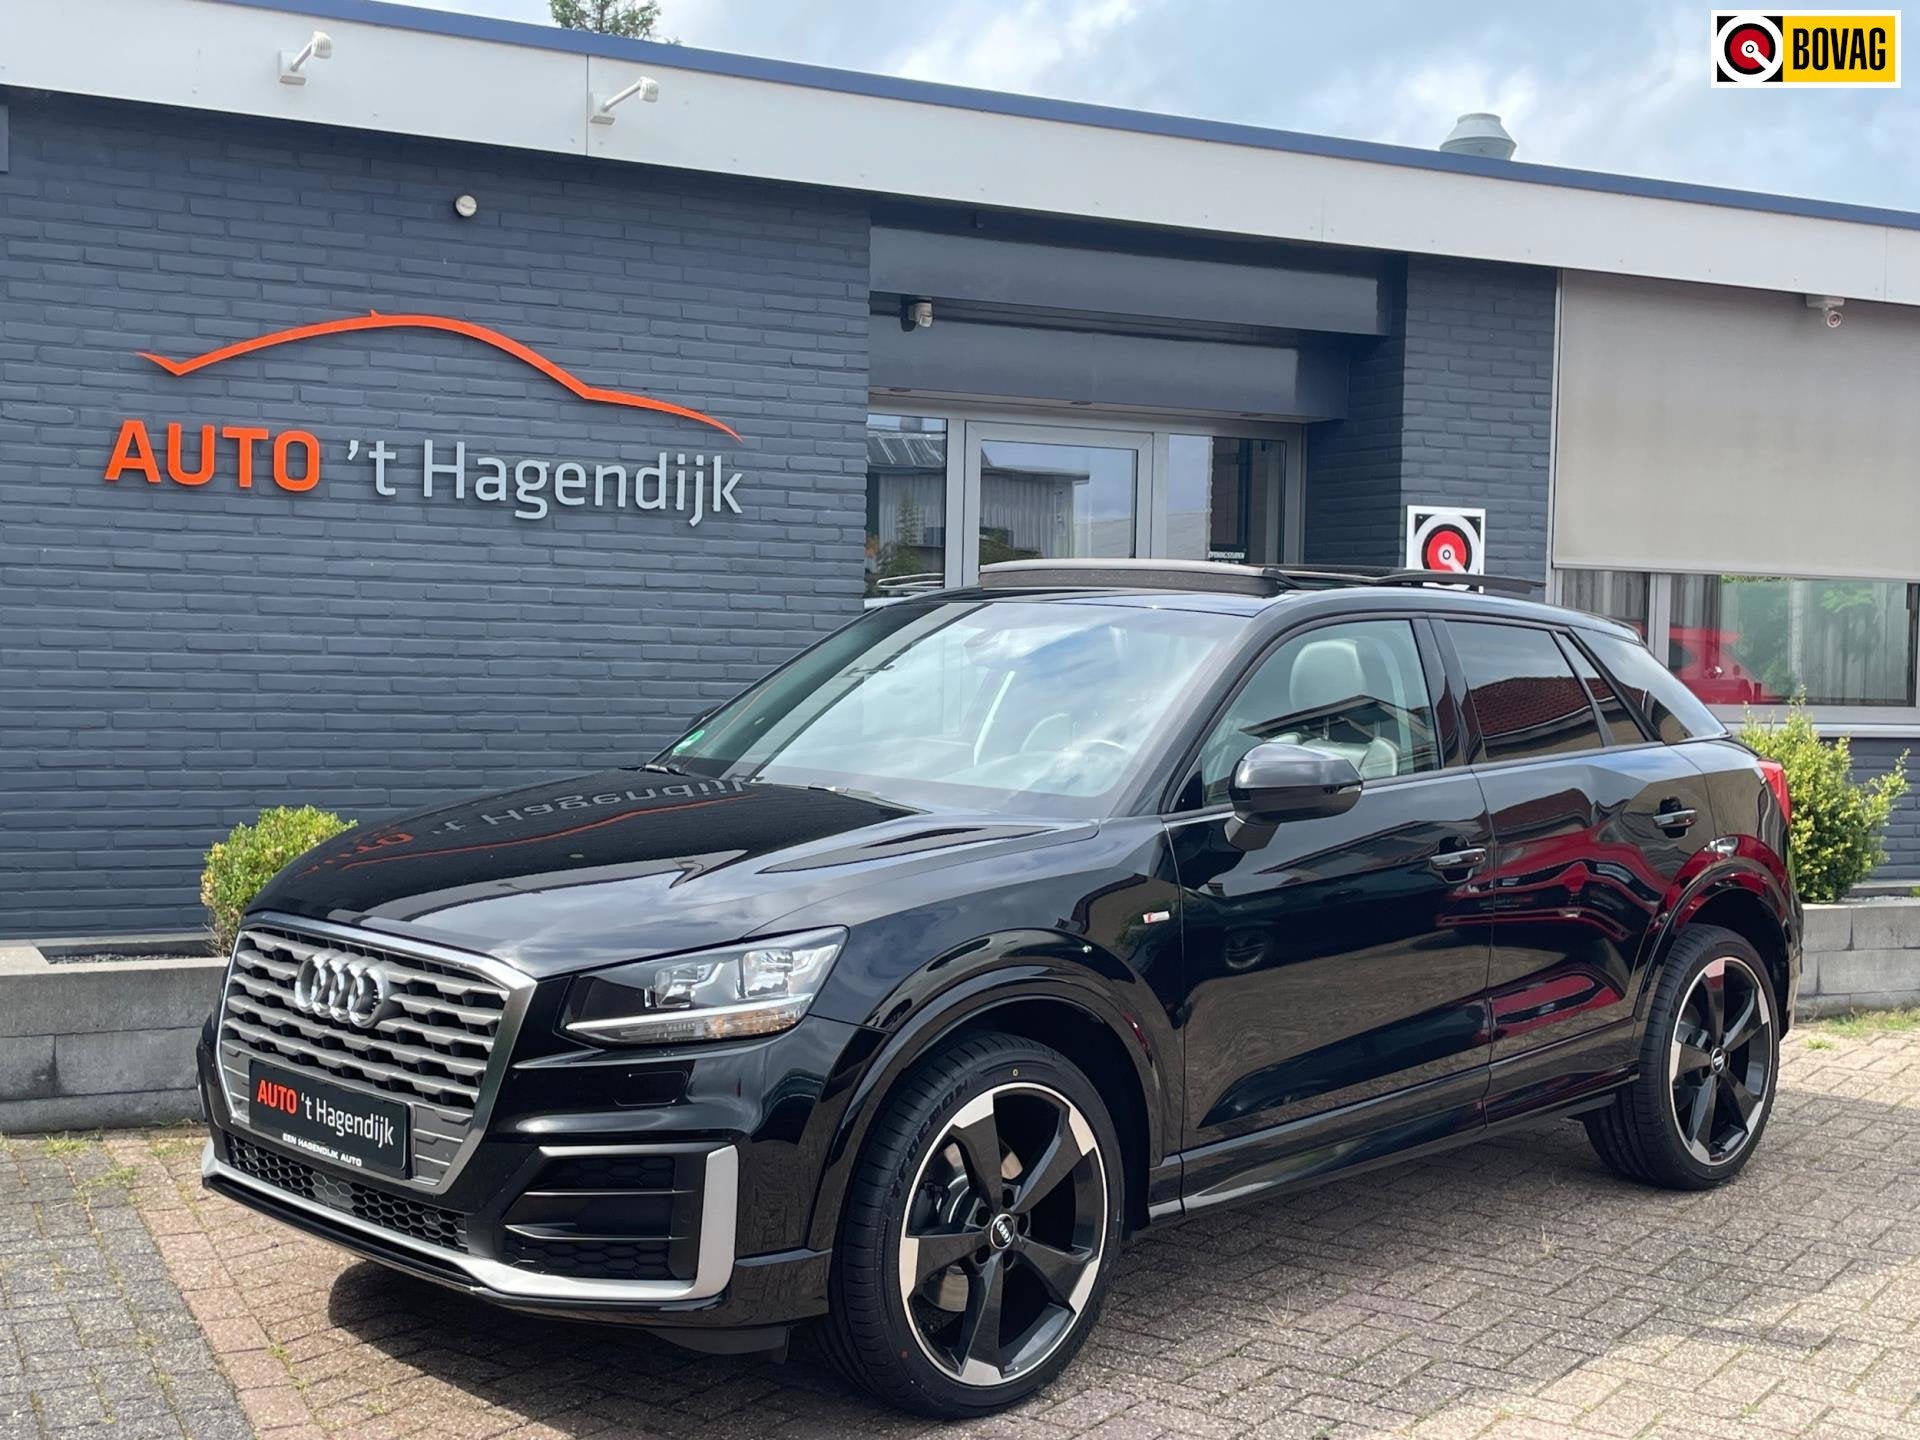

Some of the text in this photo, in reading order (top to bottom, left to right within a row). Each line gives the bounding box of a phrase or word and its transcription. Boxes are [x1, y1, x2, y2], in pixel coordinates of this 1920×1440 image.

[104, 419, 744, 527] AUTO 't Hagendijk
[257, 1079, 297, 1114] AUTO
[316, 1097, 394, 1149] Hagendijk
[282, 1132, 297, 1145] EEN
[340, 1152, 362, 1167] AUTO
